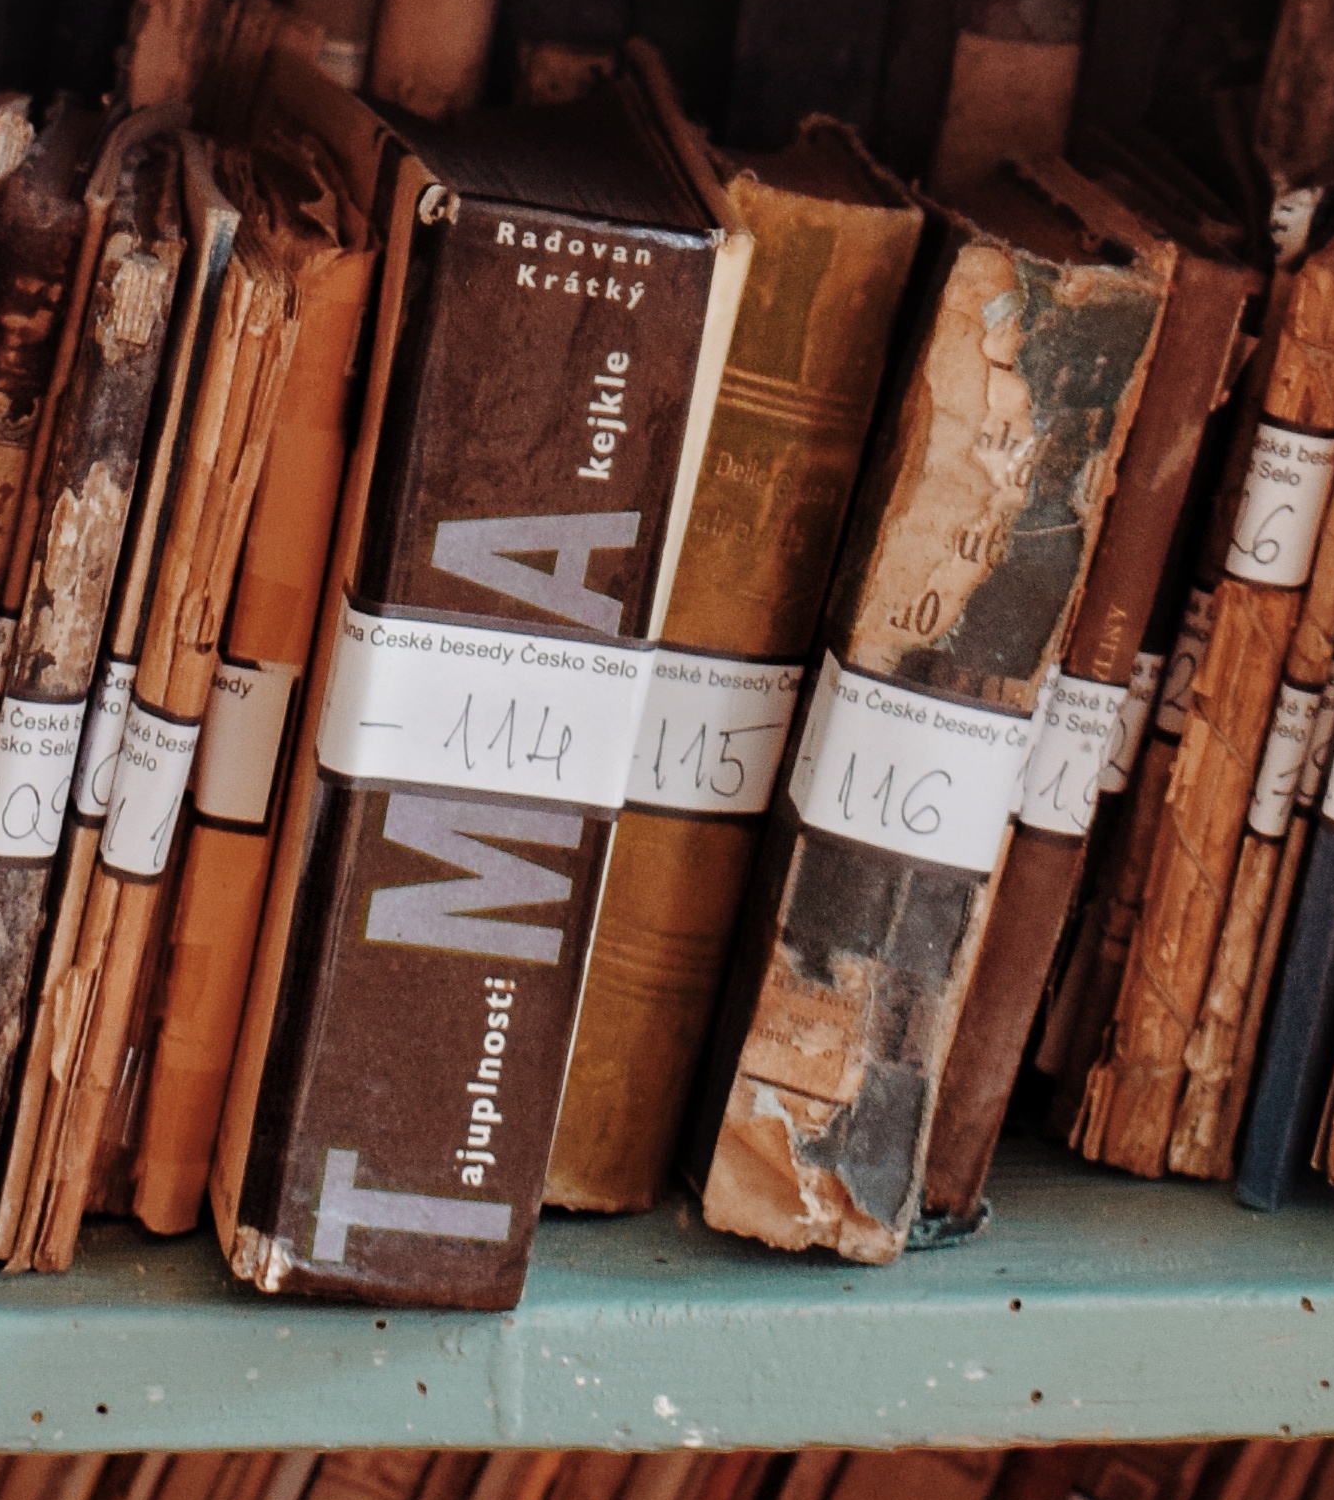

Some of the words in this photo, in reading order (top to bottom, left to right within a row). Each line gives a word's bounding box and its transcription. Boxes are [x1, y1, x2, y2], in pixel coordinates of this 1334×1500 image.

[496, 221, 651, 266] Radovan
[517, 264, 645, 310] Krátký
[578, 351, 630, 480] kejkle
[370, 624, 433, 651] České
[439, 639, 514, 666] besedy
[520, 643, 585, 672] Česko
[592, 656, 638, 681] Selo
[866, 690, 927, 725] České
[934, 711, 1000, 745] besedy
[838, 753, 952, 834] 116
